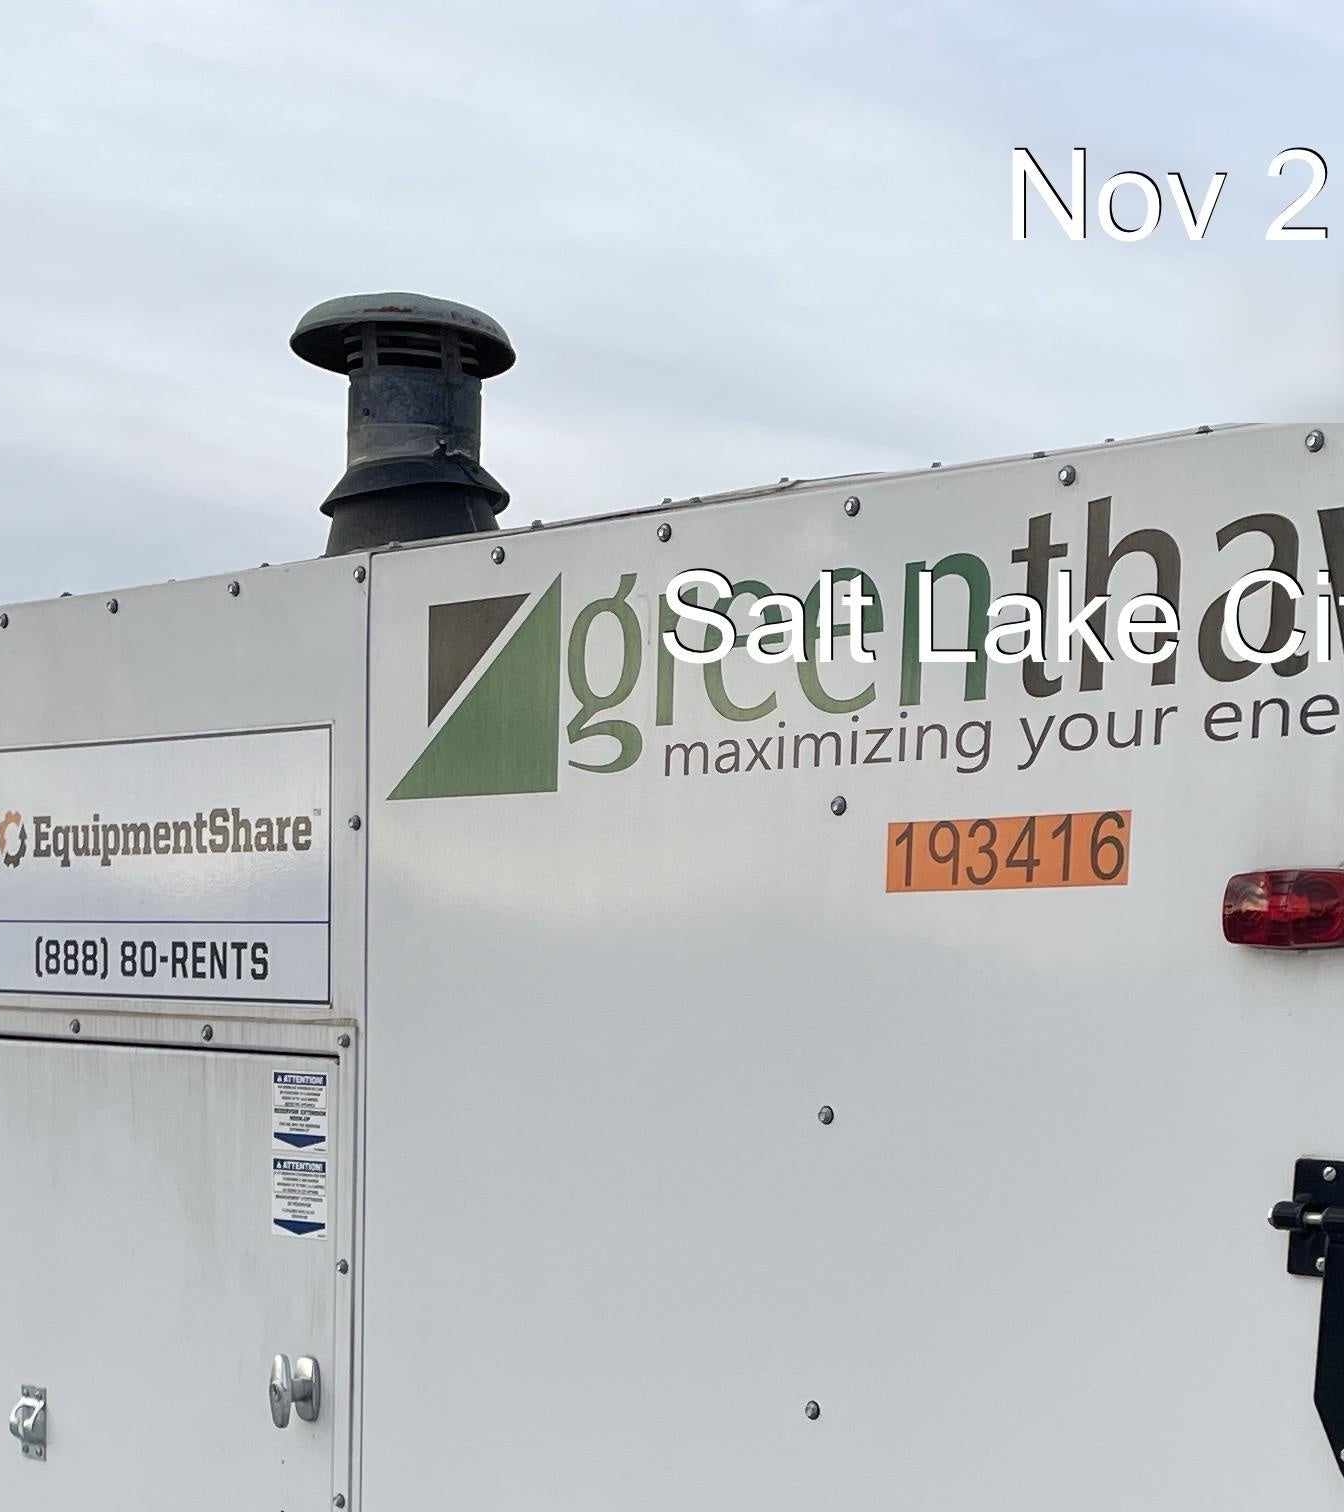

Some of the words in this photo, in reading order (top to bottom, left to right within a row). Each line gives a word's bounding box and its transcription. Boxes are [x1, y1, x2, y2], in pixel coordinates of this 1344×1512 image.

[663, 713, 993, 778] maximizing
[1018, 704, 1180, 770] your
[892, 812, 1129, 888] 193416
[35, 936, 108, 979] (888)
[120, 940, 270, 981] 80-RENTS
